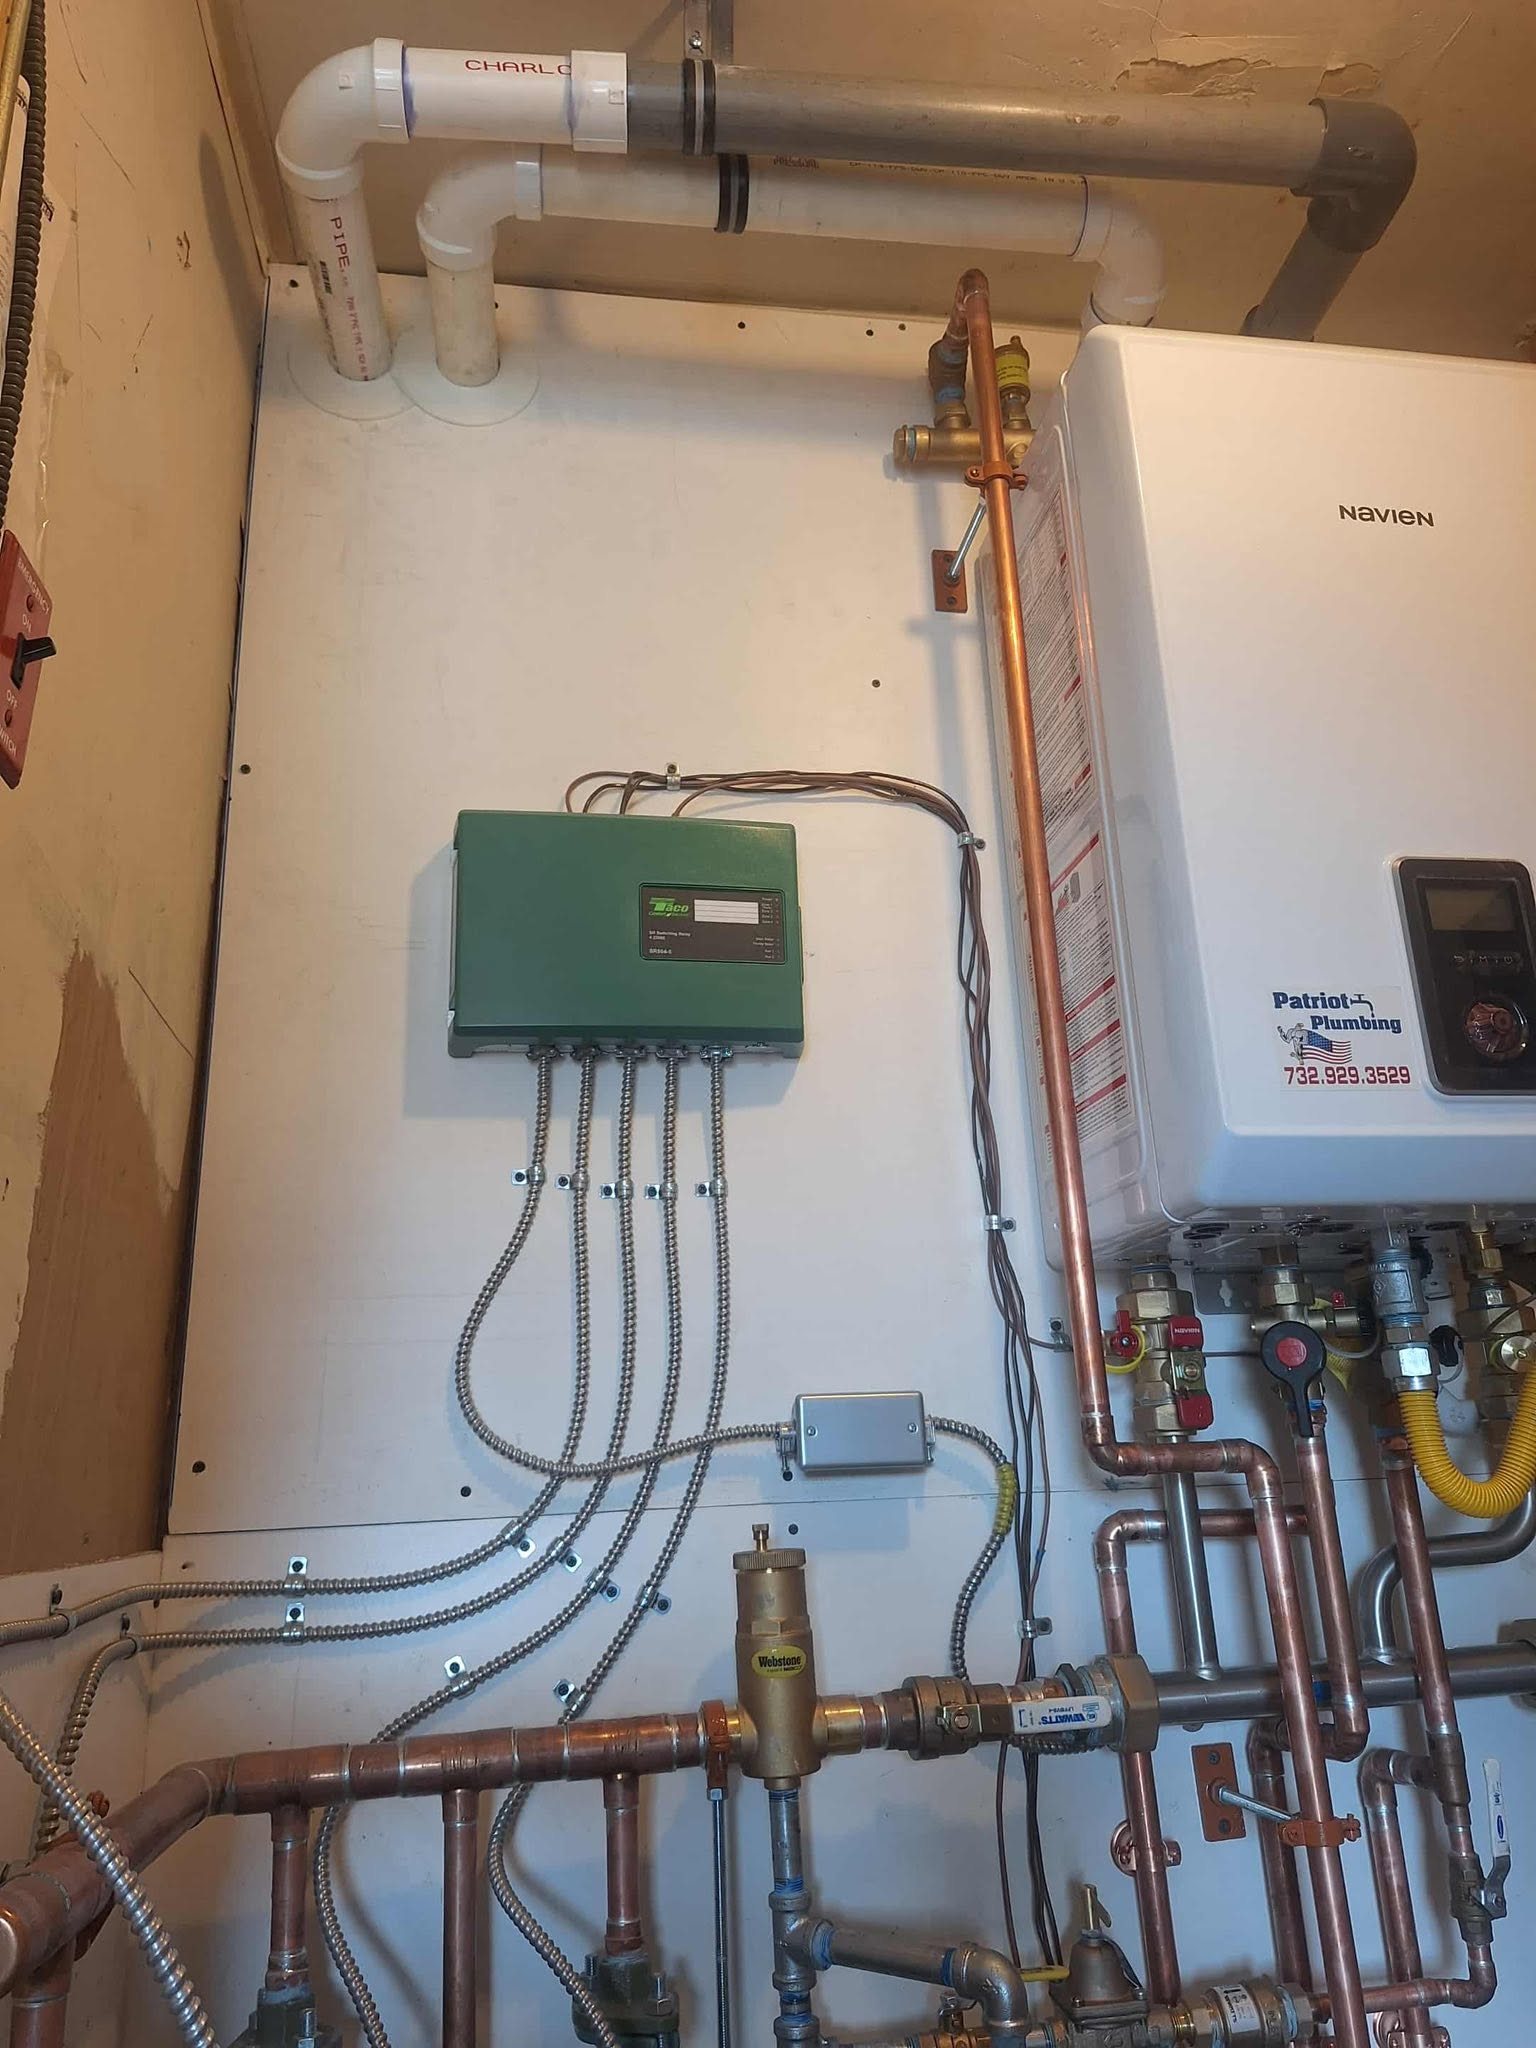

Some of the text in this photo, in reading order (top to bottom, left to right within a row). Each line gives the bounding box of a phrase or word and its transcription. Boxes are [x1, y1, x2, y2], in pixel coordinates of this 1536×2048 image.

[17, 557, 50, 616] EMERGENCY
[22, 613, 32, 633] ON
[6, 689, 18, 710] OFF
[1272, 992, 1350, 1009] Patriot
[1310, 1015, 1402, 1034] Plumbing
[1285, 1066, 1411, 1085] 732.929.3529
[758, 1655, 802, 1668] Webstone
